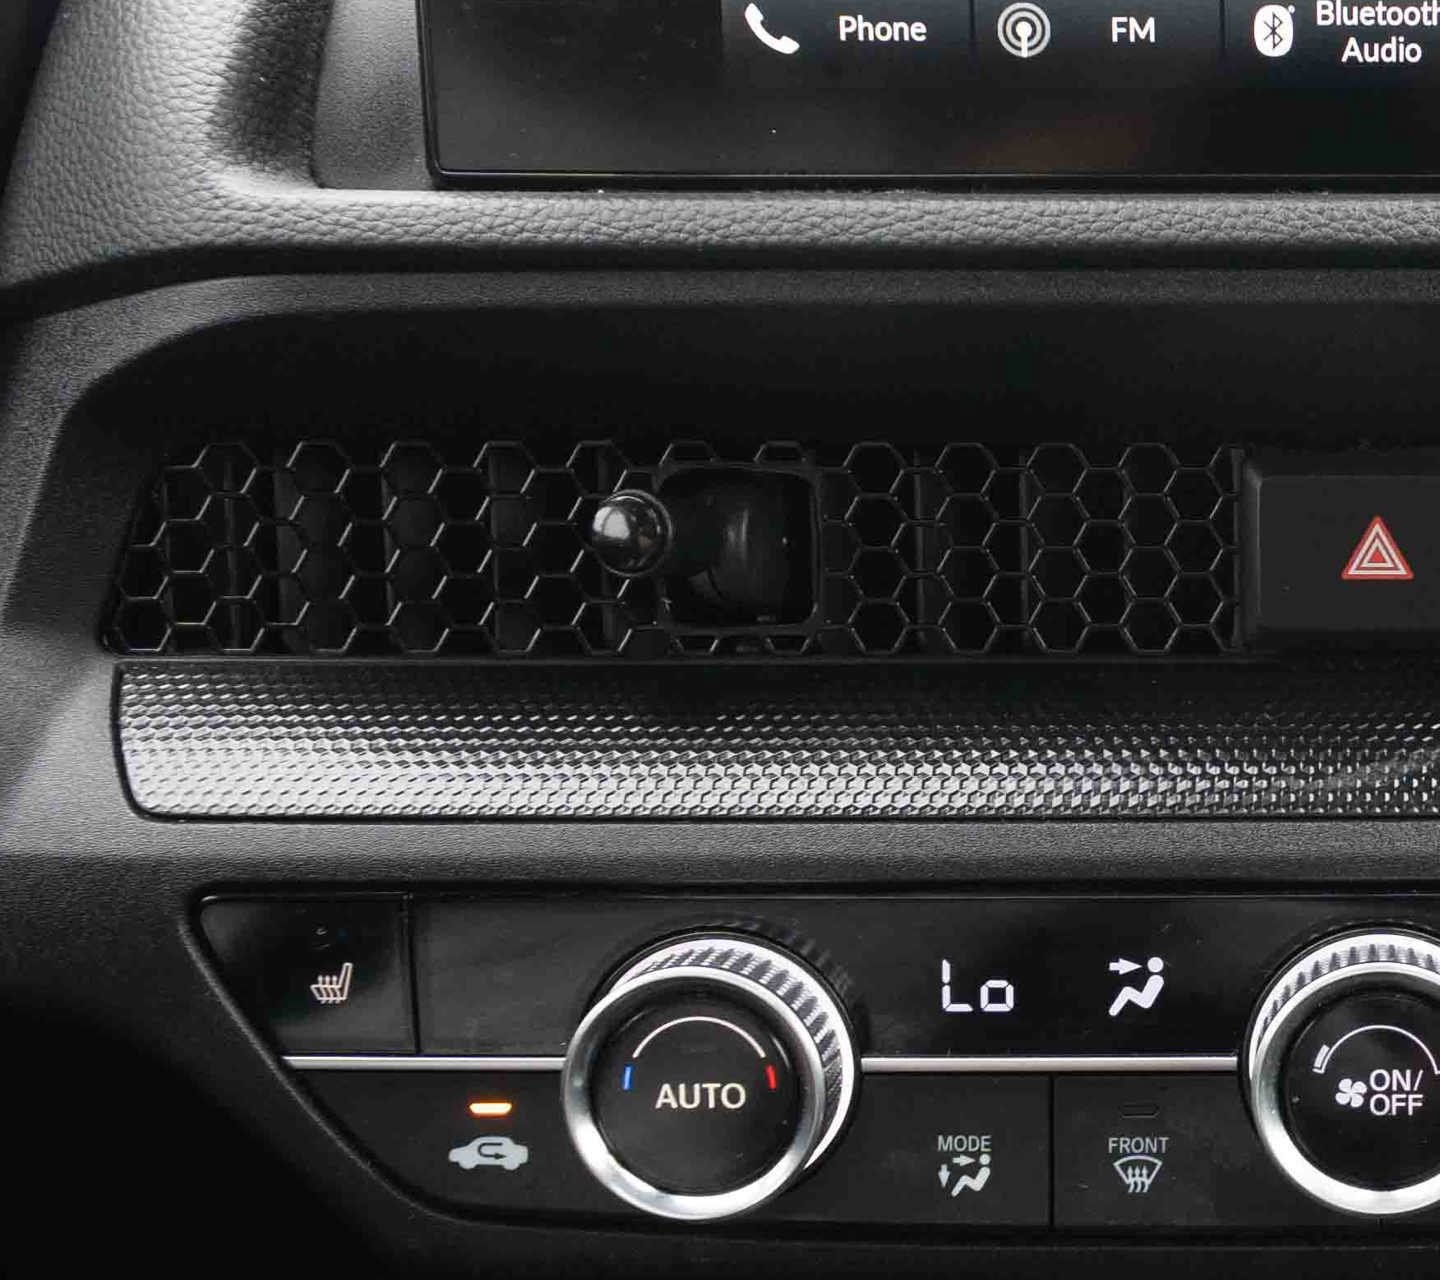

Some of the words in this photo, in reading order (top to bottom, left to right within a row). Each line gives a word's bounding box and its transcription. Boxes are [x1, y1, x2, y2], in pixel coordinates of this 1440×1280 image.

[838, 14, 927, 42] Phone
[1111, 16, 1156, 43] FM
[1341, 35, 1423, 63] Audio
[941, 959, 1015, 1013] Lo
[655, 1082, 746, 1109] AUTO
[1369, 1068, 1423, 1096] ON/
[1369, 1093, 1424, 1116] OFF
[937, 1134, 992, 1152] MODE
[1108, 1136, 1169, 1154] FRONT
